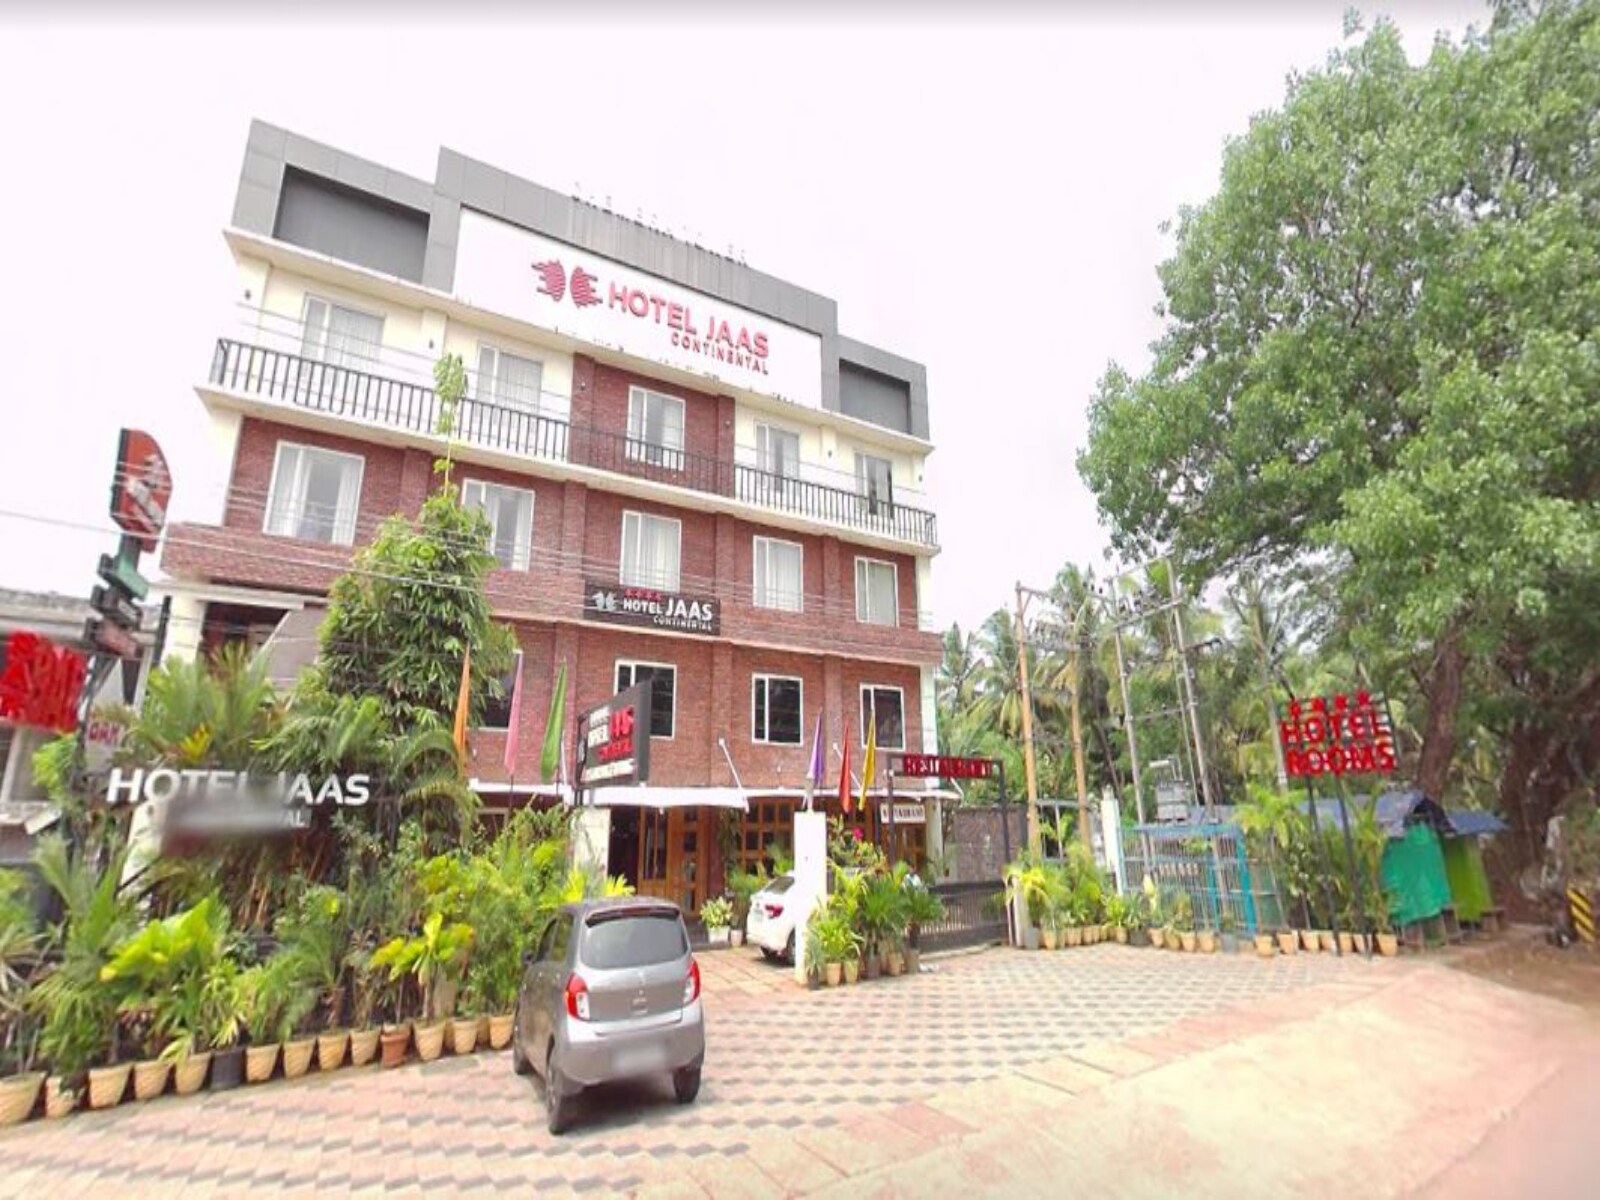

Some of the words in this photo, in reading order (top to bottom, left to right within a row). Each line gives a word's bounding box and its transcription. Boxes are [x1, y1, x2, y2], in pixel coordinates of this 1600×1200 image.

[608, 281, 697, 335] HOTEL
[707, 316, 769, 359] JAAS
[671, 333, 769, 376] CONTINENTAL
[622, 597, 663, 615] HOTEL
[664, 596, 713, 621] JAAS
[653, 614, 712, 632] CONTINENTAL
[1280, 709, 1391, 746] HOTEL
[1286, 742, 1395, 777] ROOMS
